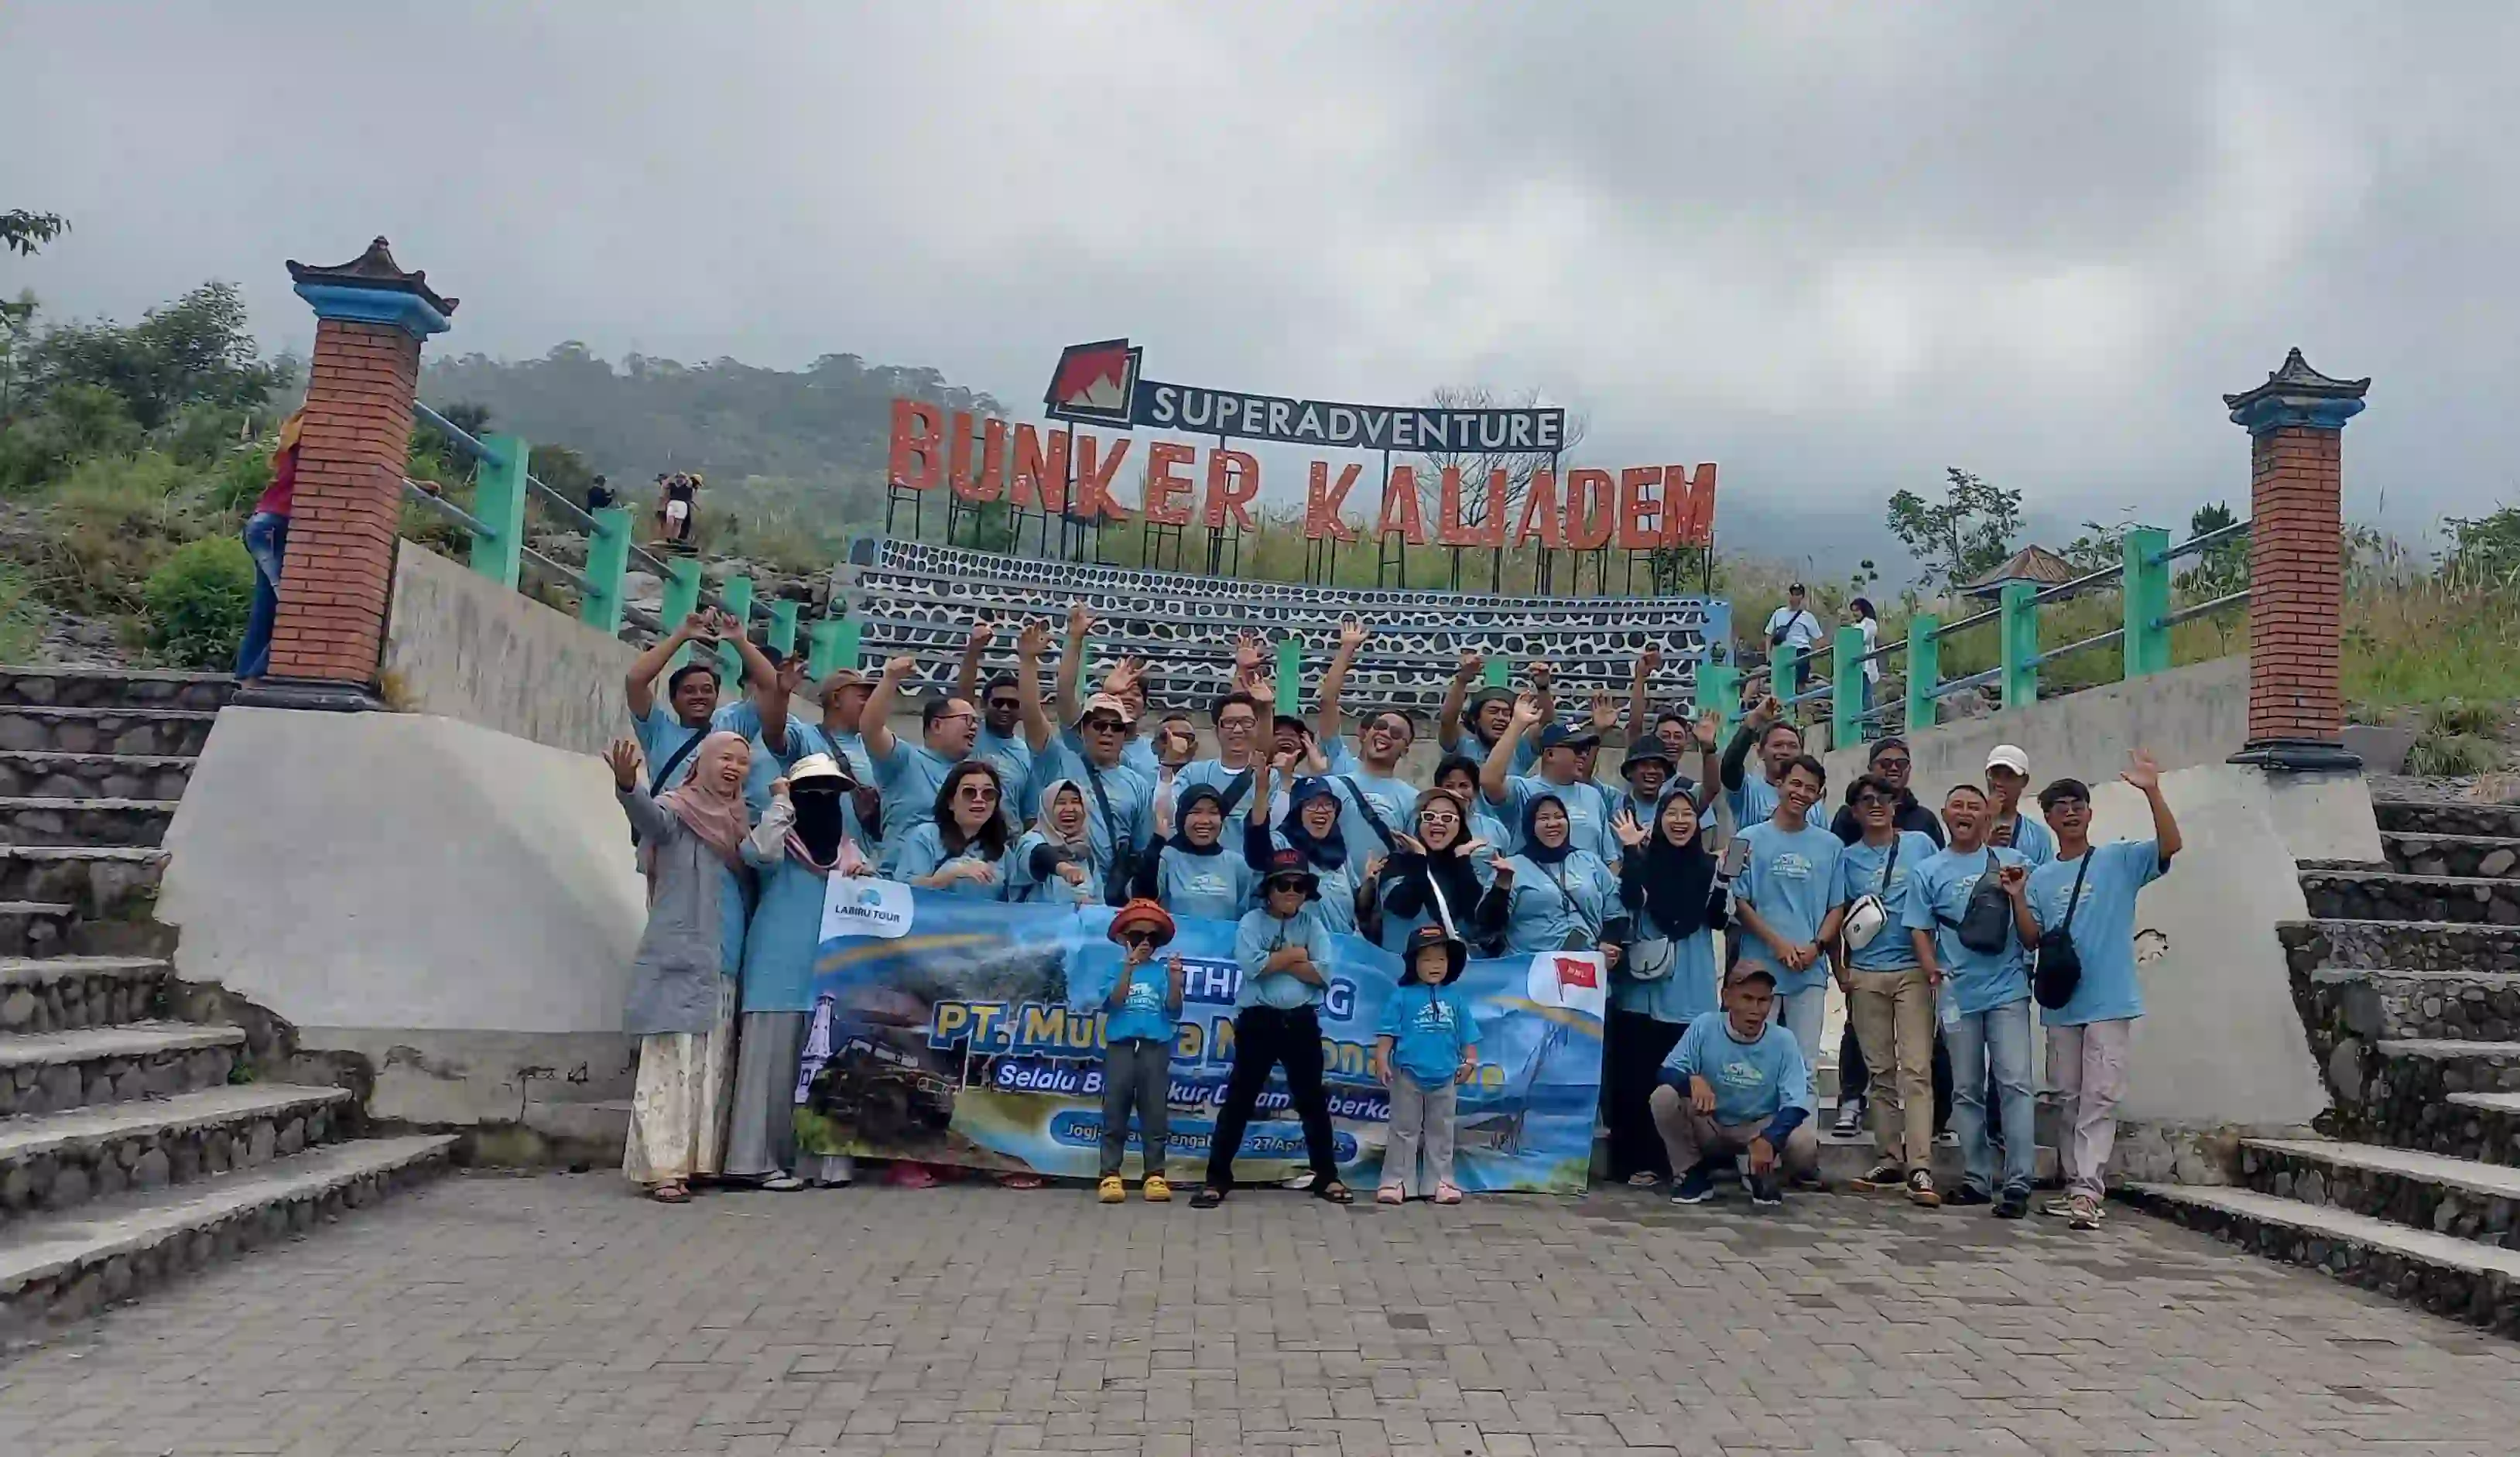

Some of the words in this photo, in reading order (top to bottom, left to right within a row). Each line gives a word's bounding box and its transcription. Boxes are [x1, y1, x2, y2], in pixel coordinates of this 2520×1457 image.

[1152, 387, 1560, 448] SUPERADVENTURE
[888, 395, 1260, 532] BUNKER
[1305, 461, 1717, 550] KALIADEM
[873, 910, 900, 923] TOUR
[936, 1005, 1007, 1043] PT.
[998, 1064, 1077, 1091] Selalu
